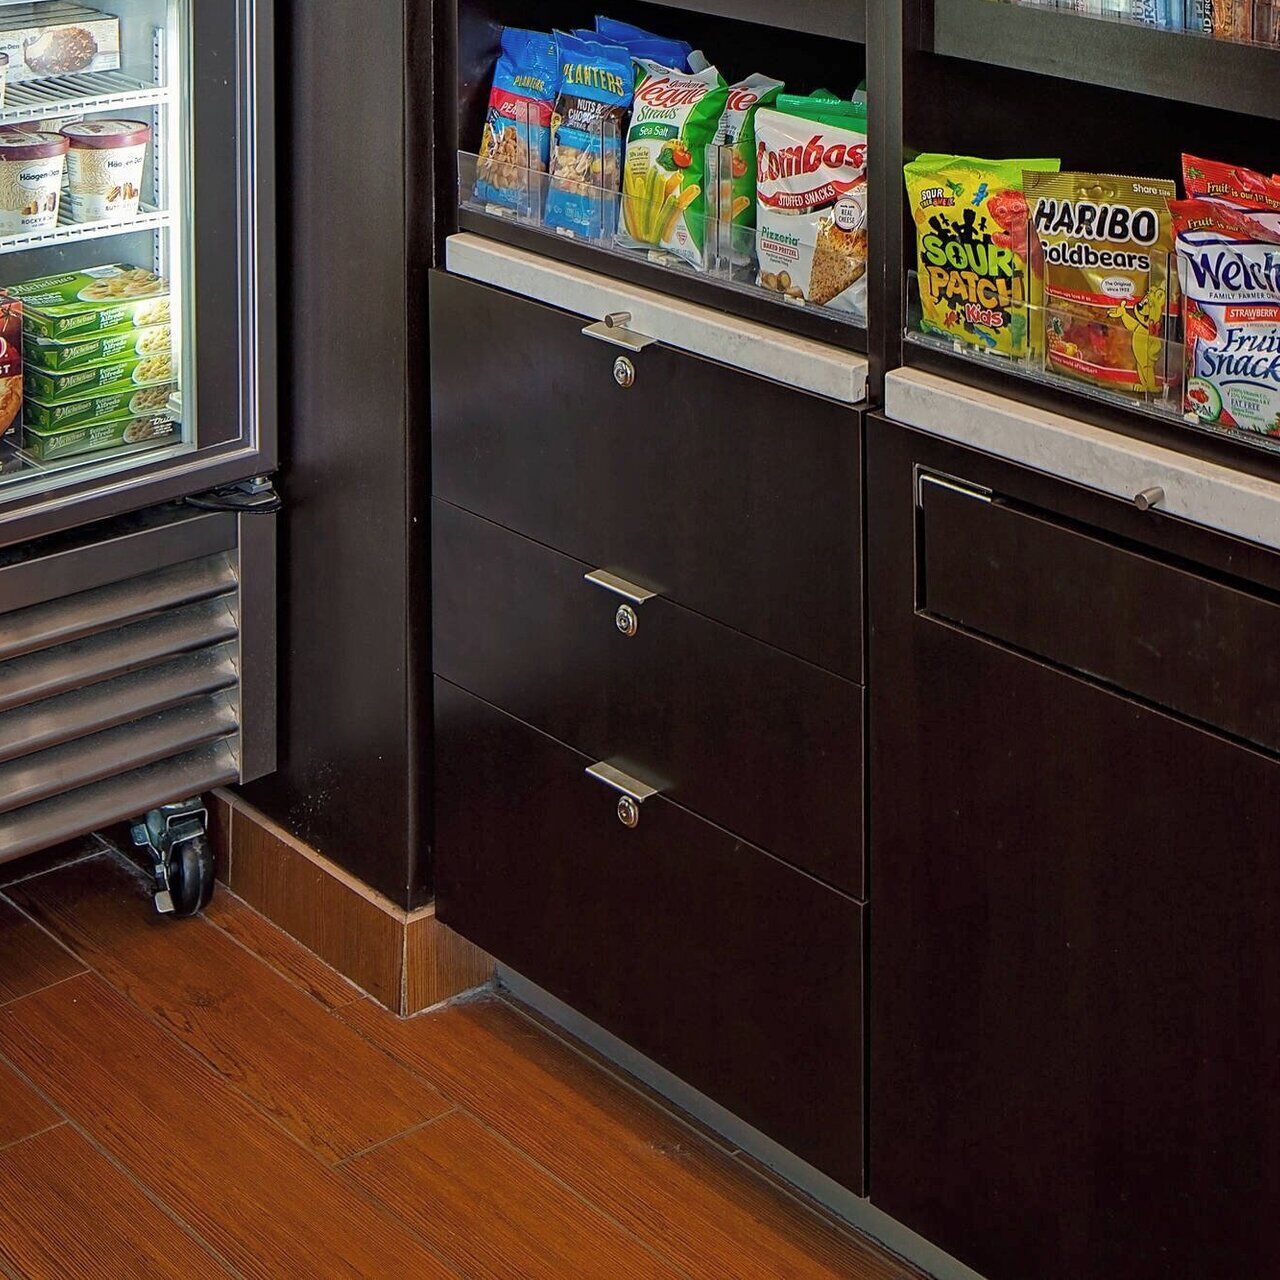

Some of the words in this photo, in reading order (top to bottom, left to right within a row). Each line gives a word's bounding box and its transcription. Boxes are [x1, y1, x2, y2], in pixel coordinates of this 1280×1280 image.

[563, 63, 625, 97] PLANTERS
[638, 125, 652, 136] Sea
[653, 125, 670, 137] Salt
[756, 132, 867, 183] Combos
[778, 192, 803, 207] STUFFED
[803, 184, 836, 204] SNACKS
[1132, 183, 1158, 195] Share
[1034, 199, 1158, 244] HARIBO
[925, 234, 1014, 276] SOUR
[928, 268, 1024, 309] PATCH
[1209, 291, 1235, 300] FAMILY
[965, 304, 1003, 327] Kids
[1229, 307, 1279, 320] STRAWBERRY
